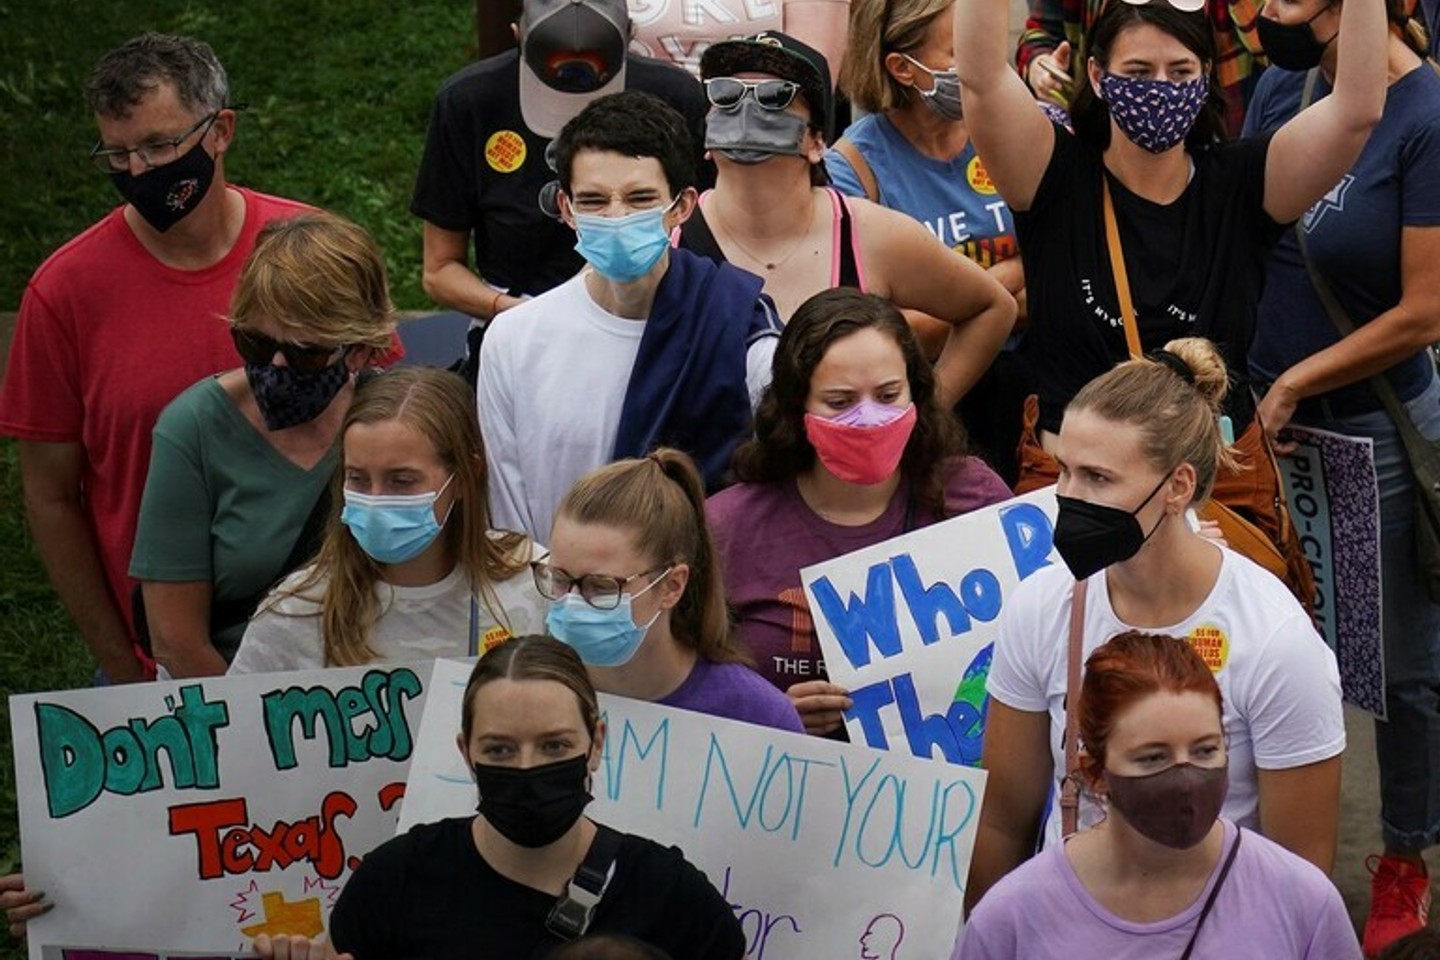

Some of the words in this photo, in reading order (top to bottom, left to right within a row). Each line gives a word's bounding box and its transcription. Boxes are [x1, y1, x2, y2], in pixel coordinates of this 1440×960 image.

[772, 655, 811, 675] THE
[808, 552, 1003, 671] Who
[35, 684, 231, 819] Don't
[260, 667, 424, 771] mess
[845, 671, 985, 768] The
[693, 732, 837, 841] NOT
[834, 754, 975, 892] YOUR
